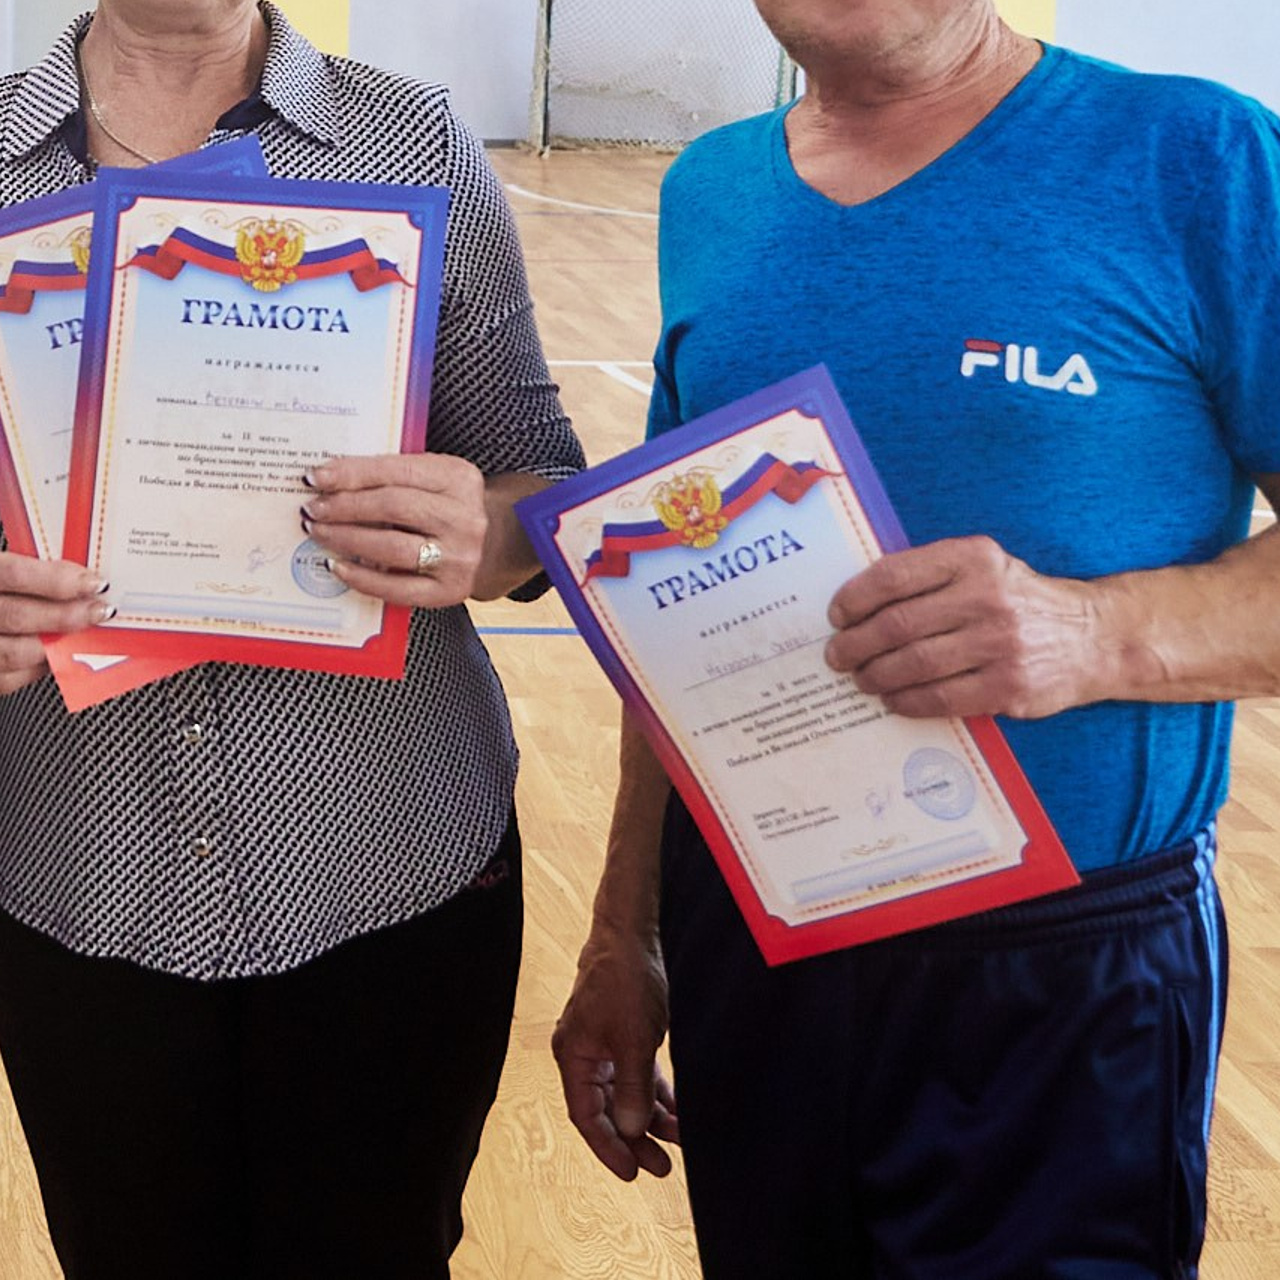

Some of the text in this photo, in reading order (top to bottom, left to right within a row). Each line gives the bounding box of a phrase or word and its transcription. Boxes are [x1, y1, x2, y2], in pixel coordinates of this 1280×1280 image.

[181, 298, 350, 333] ГРАМОТА
[960, 338, 1098, 396] FILA
[649, 530, 806, 611] ГРАМОТА
